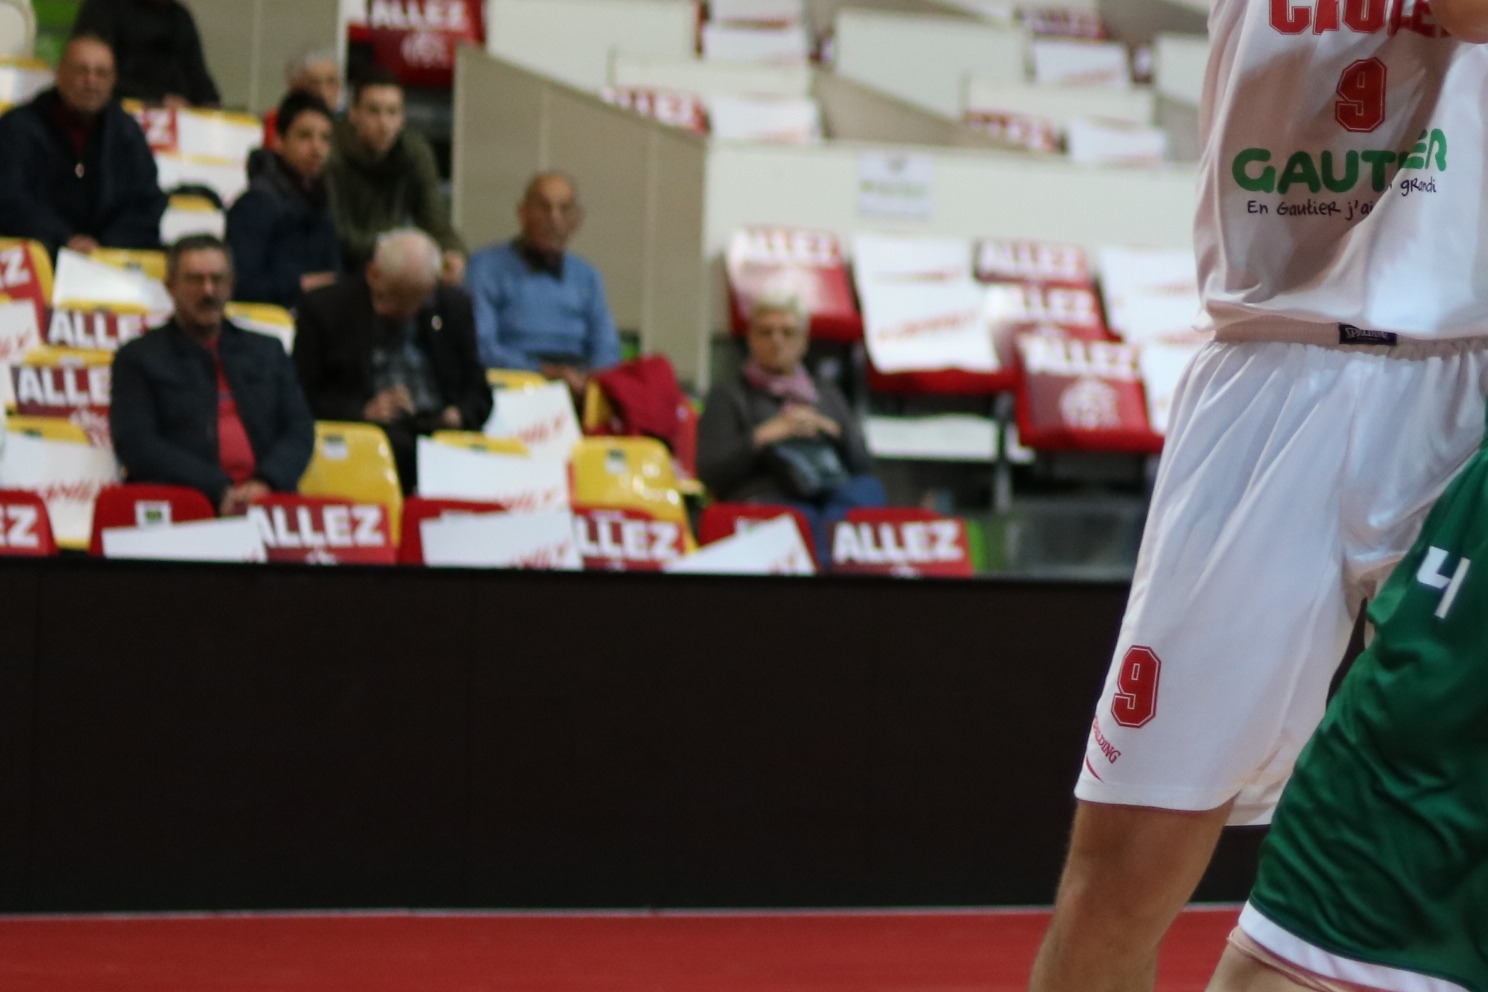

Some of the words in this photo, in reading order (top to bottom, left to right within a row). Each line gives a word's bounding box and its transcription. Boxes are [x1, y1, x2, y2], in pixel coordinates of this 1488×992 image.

[1335, 57, 1387, 133] 9
[1232, 128, 1448, 194] GAUTER
[1247, 200, 1268, 214] En
[48, 310, 146, 350] ALLE
[17, 366, 110, 406] ALLE
[575, 515, 680, 560] LLEZ
[832, 519, 962, 561] ALLEZ
[1418, 546, 1471, 619] 4
[1112, 645, 1162, 728] 9
